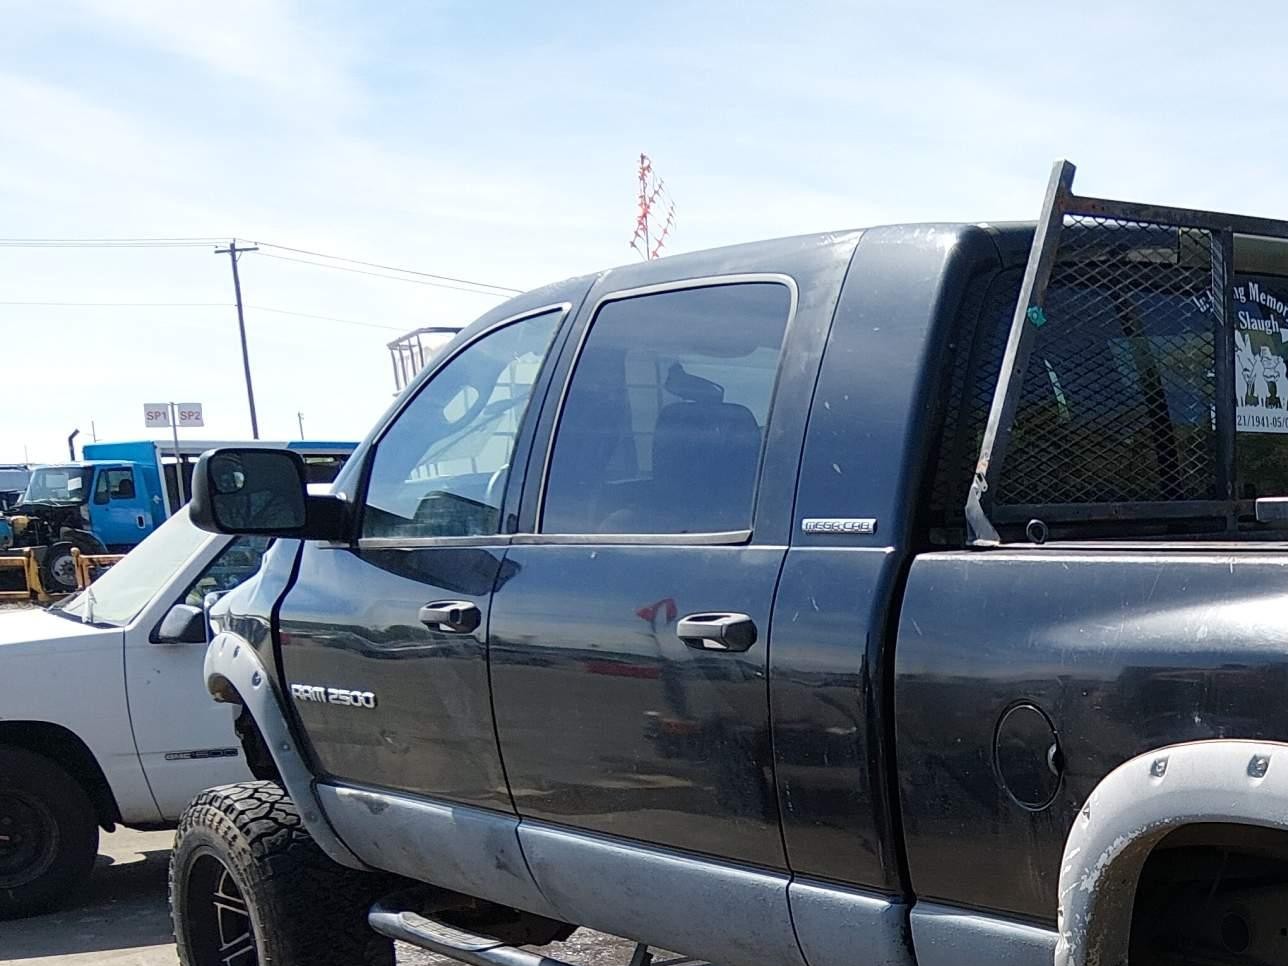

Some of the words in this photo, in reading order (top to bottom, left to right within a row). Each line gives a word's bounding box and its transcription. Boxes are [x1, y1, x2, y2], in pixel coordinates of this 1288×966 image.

[1238, 311, 1279, 335] Slaugh
[146, 410, 167, 421] SP1
[180, 410, 201, 421] SP2
[805, 521, 840, 530] MEGA
[843, 521, 870, 530] CAB
[291, 684, 326, 703] RAM
[327, 688, 375, 708] 2500
